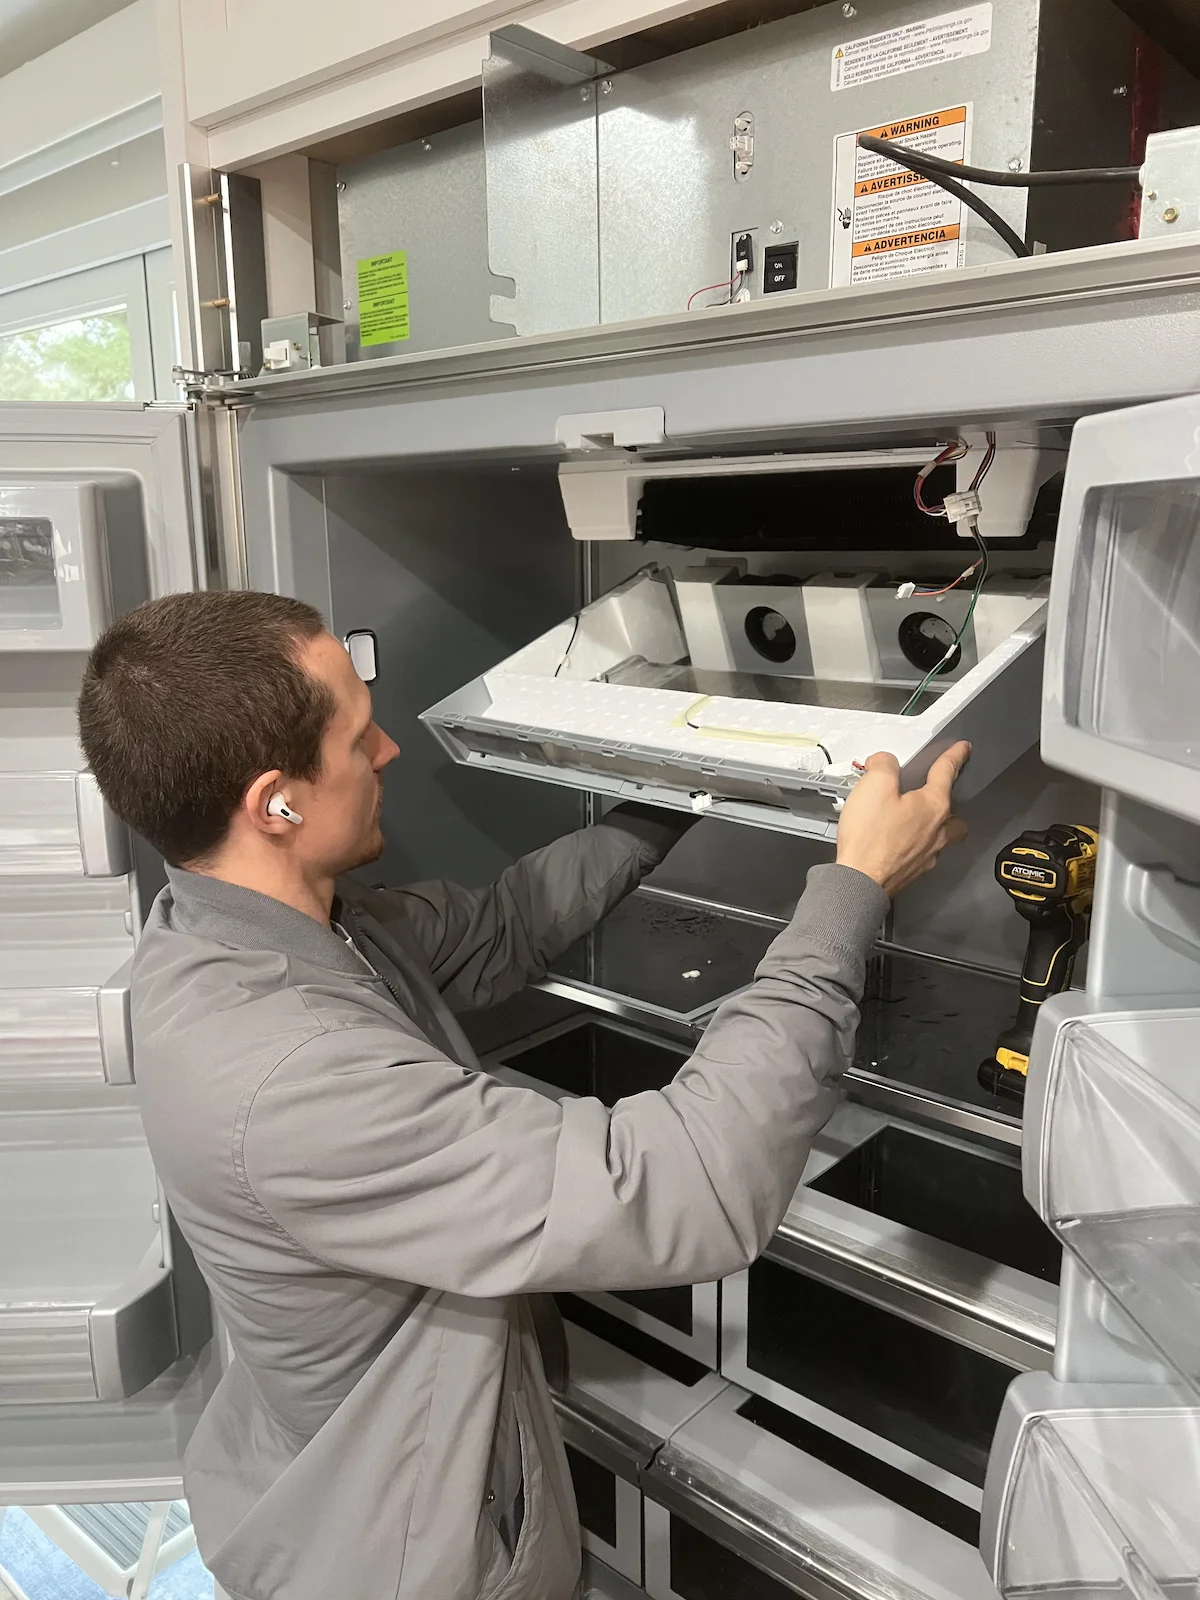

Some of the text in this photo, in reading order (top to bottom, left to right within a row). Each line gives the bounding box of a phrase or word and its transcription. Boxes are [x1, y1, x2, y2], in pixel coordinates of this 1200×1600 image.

[891, 116, 939, 135] WARNING
[874, 230, 946, 250] ADVERTENCIA
[371, 257, 393, 266] IMPORTANT
[373, 299, 395, 307] IMPORTANT
[1012, 866, 1045, 878] ATOMIC
